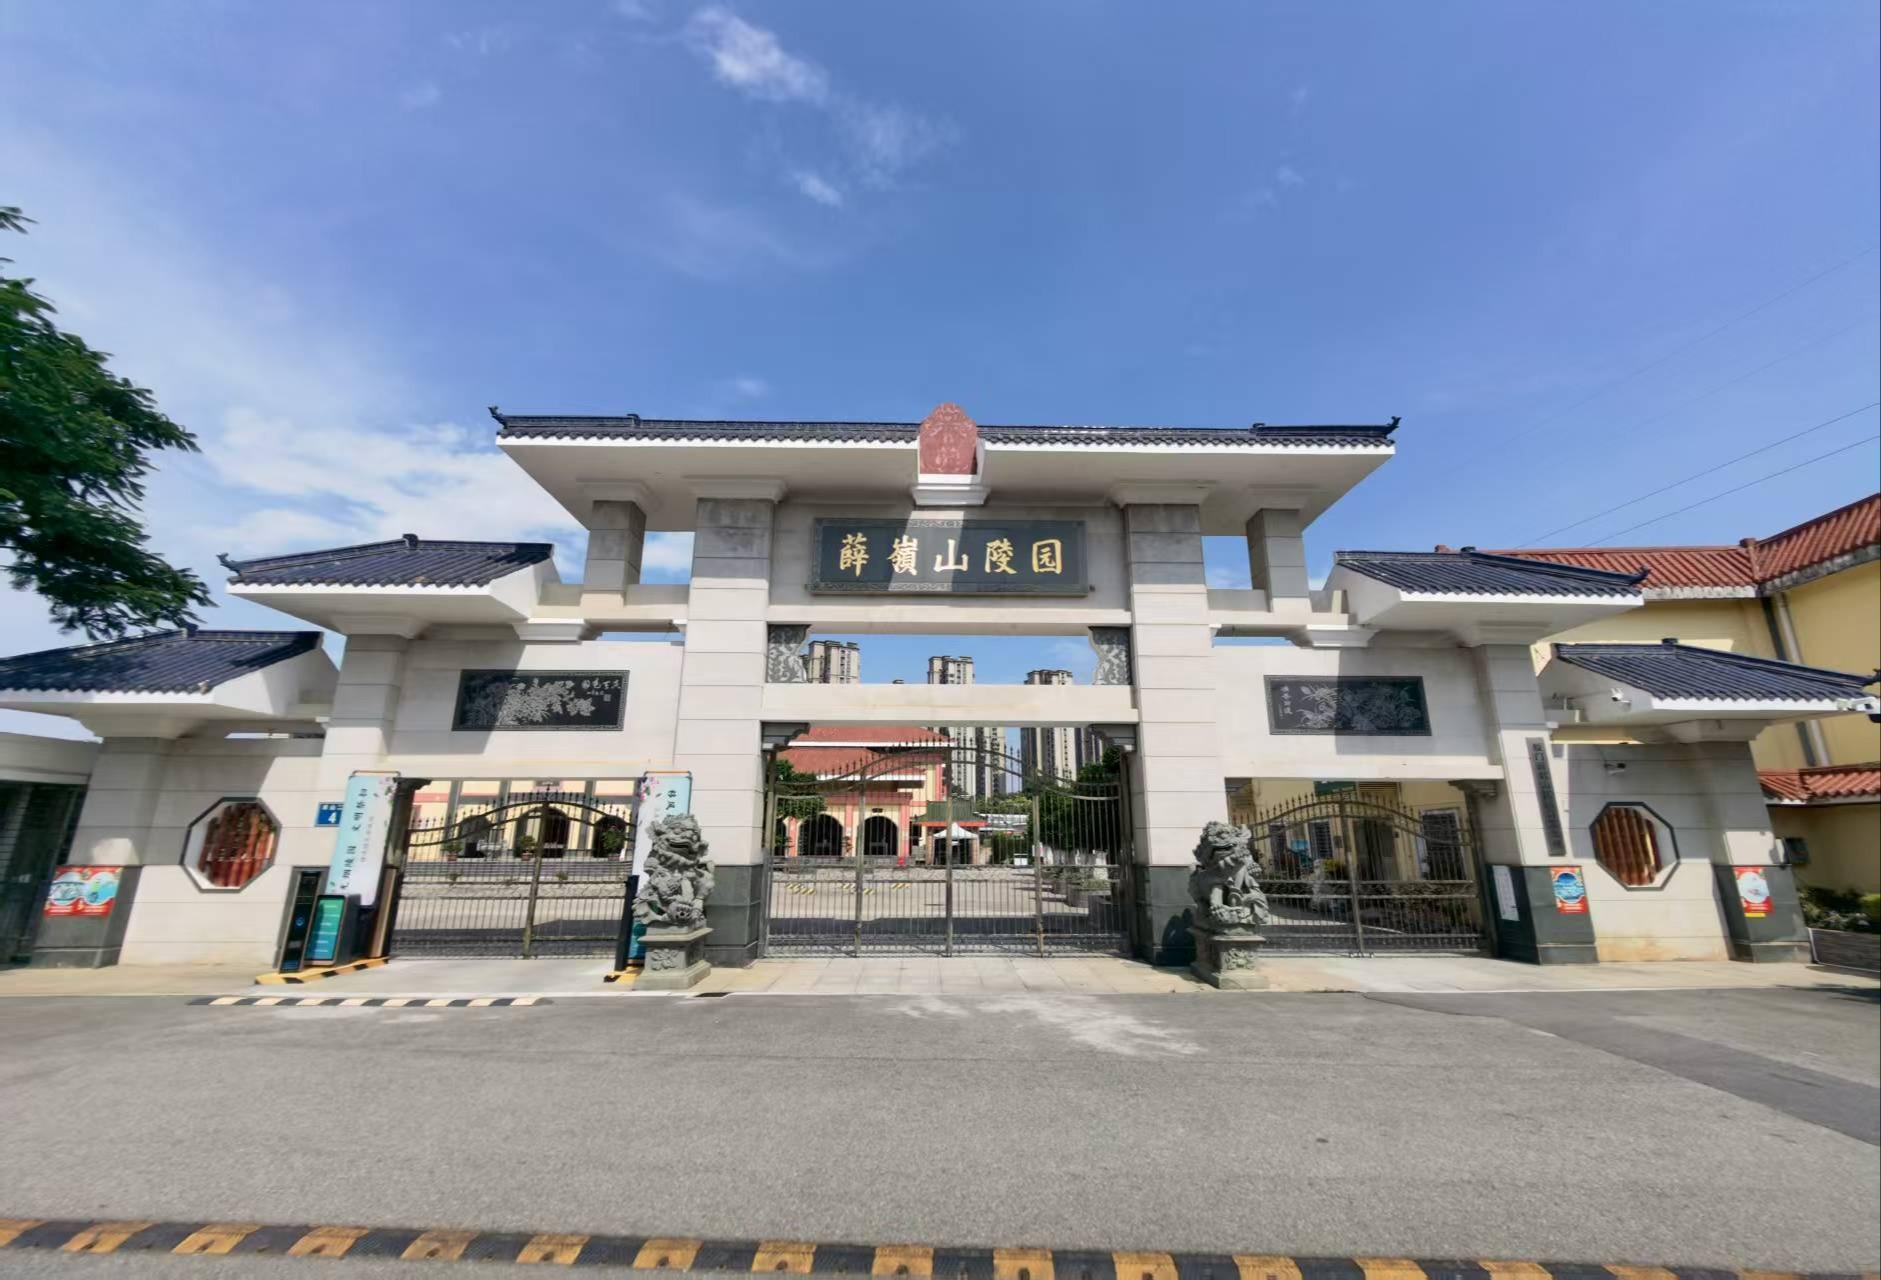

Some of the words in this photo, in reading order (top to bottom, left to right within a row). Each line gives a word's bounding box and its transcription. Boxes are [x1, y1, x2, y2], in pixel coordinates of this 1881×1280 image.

[839, 532, 1062, 577] 薛嶺山陵园
